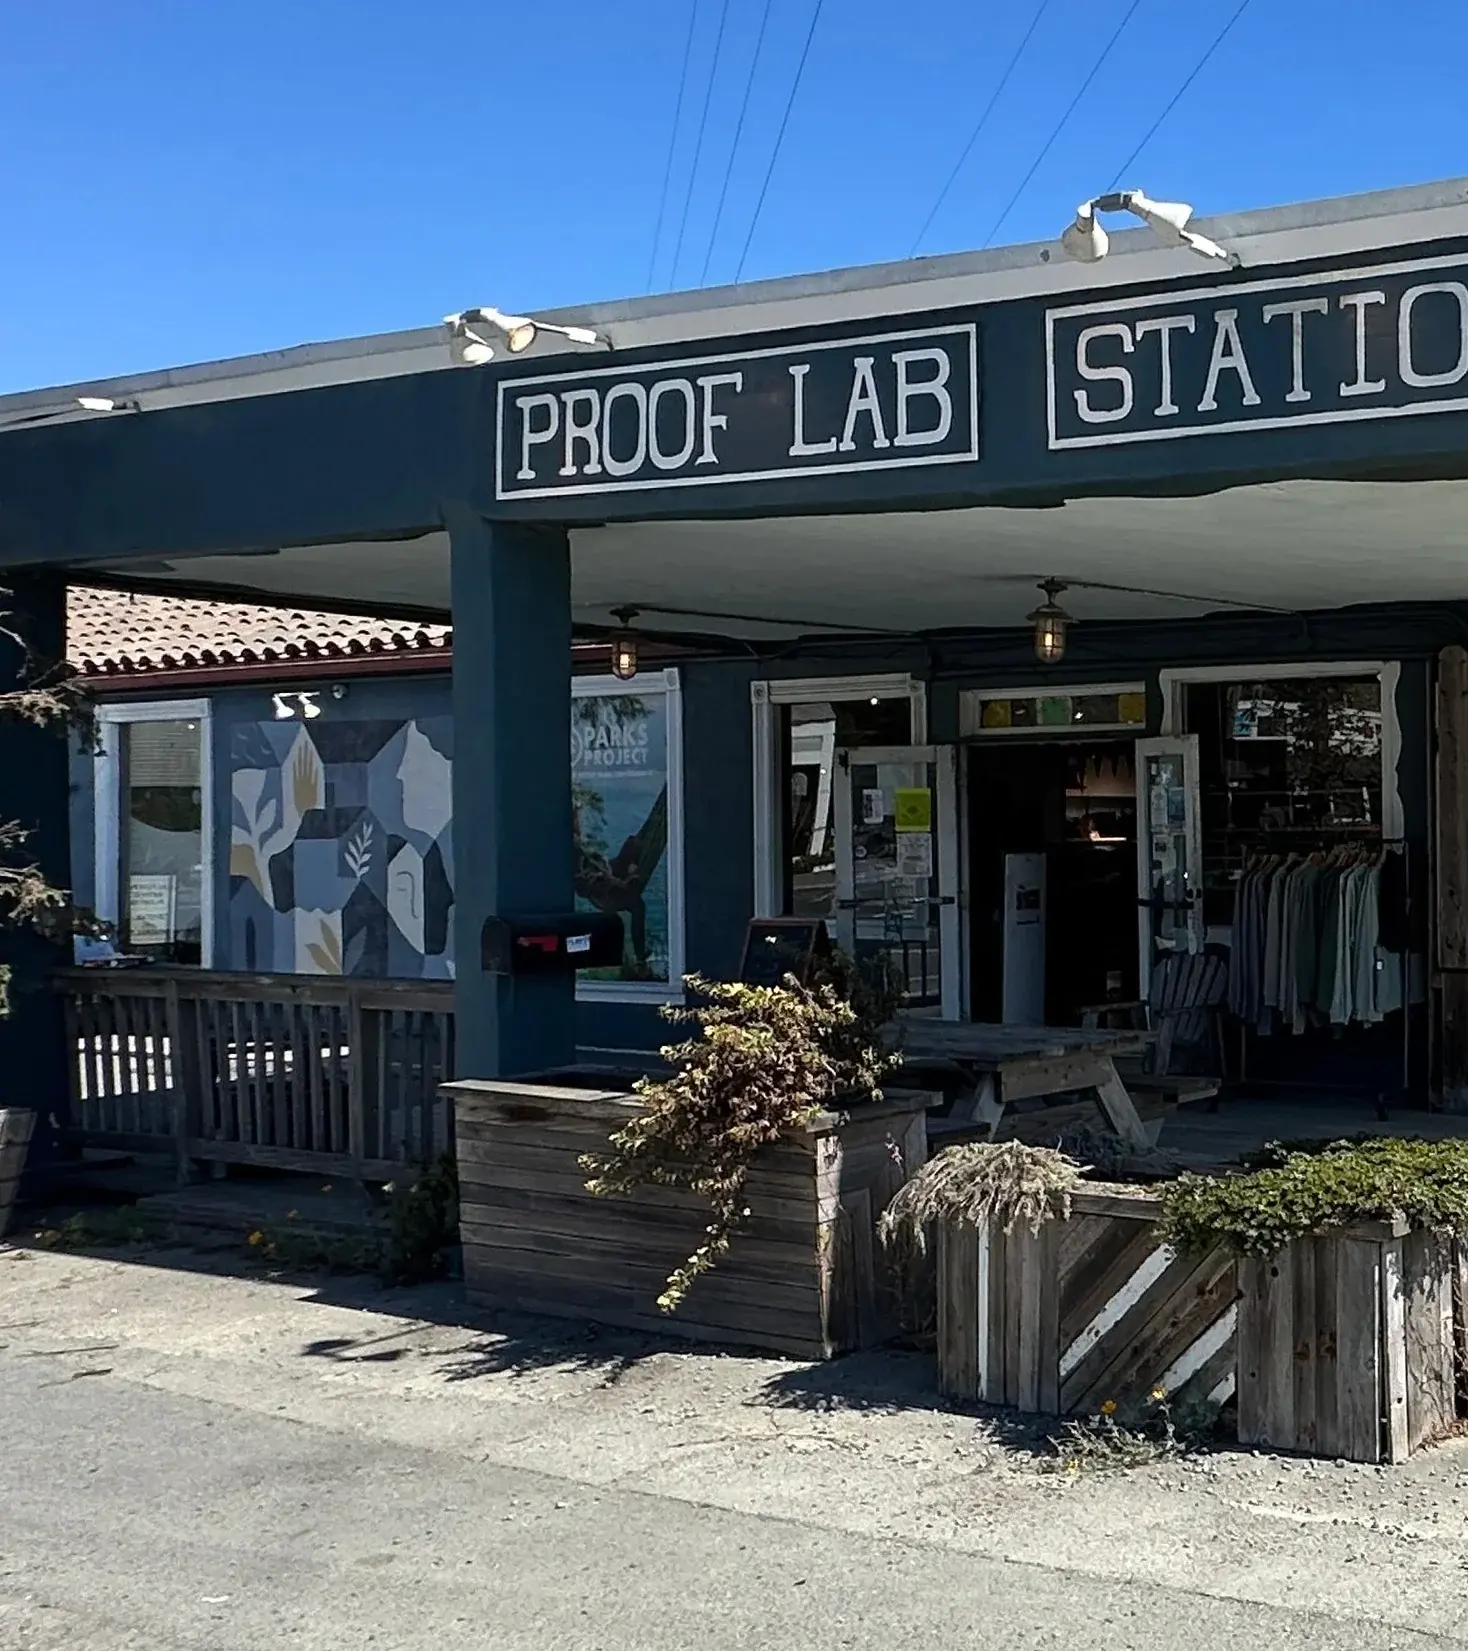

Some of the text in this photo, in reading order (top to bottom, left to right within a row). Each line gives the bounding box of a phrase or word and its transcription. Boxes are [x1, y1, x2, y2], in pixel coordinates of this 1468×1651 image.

[516, 348, 952, 479] PROOF LAB
[583, 723, 648, 748] PARKS
[583, 747, 648, 766] PROJECT
